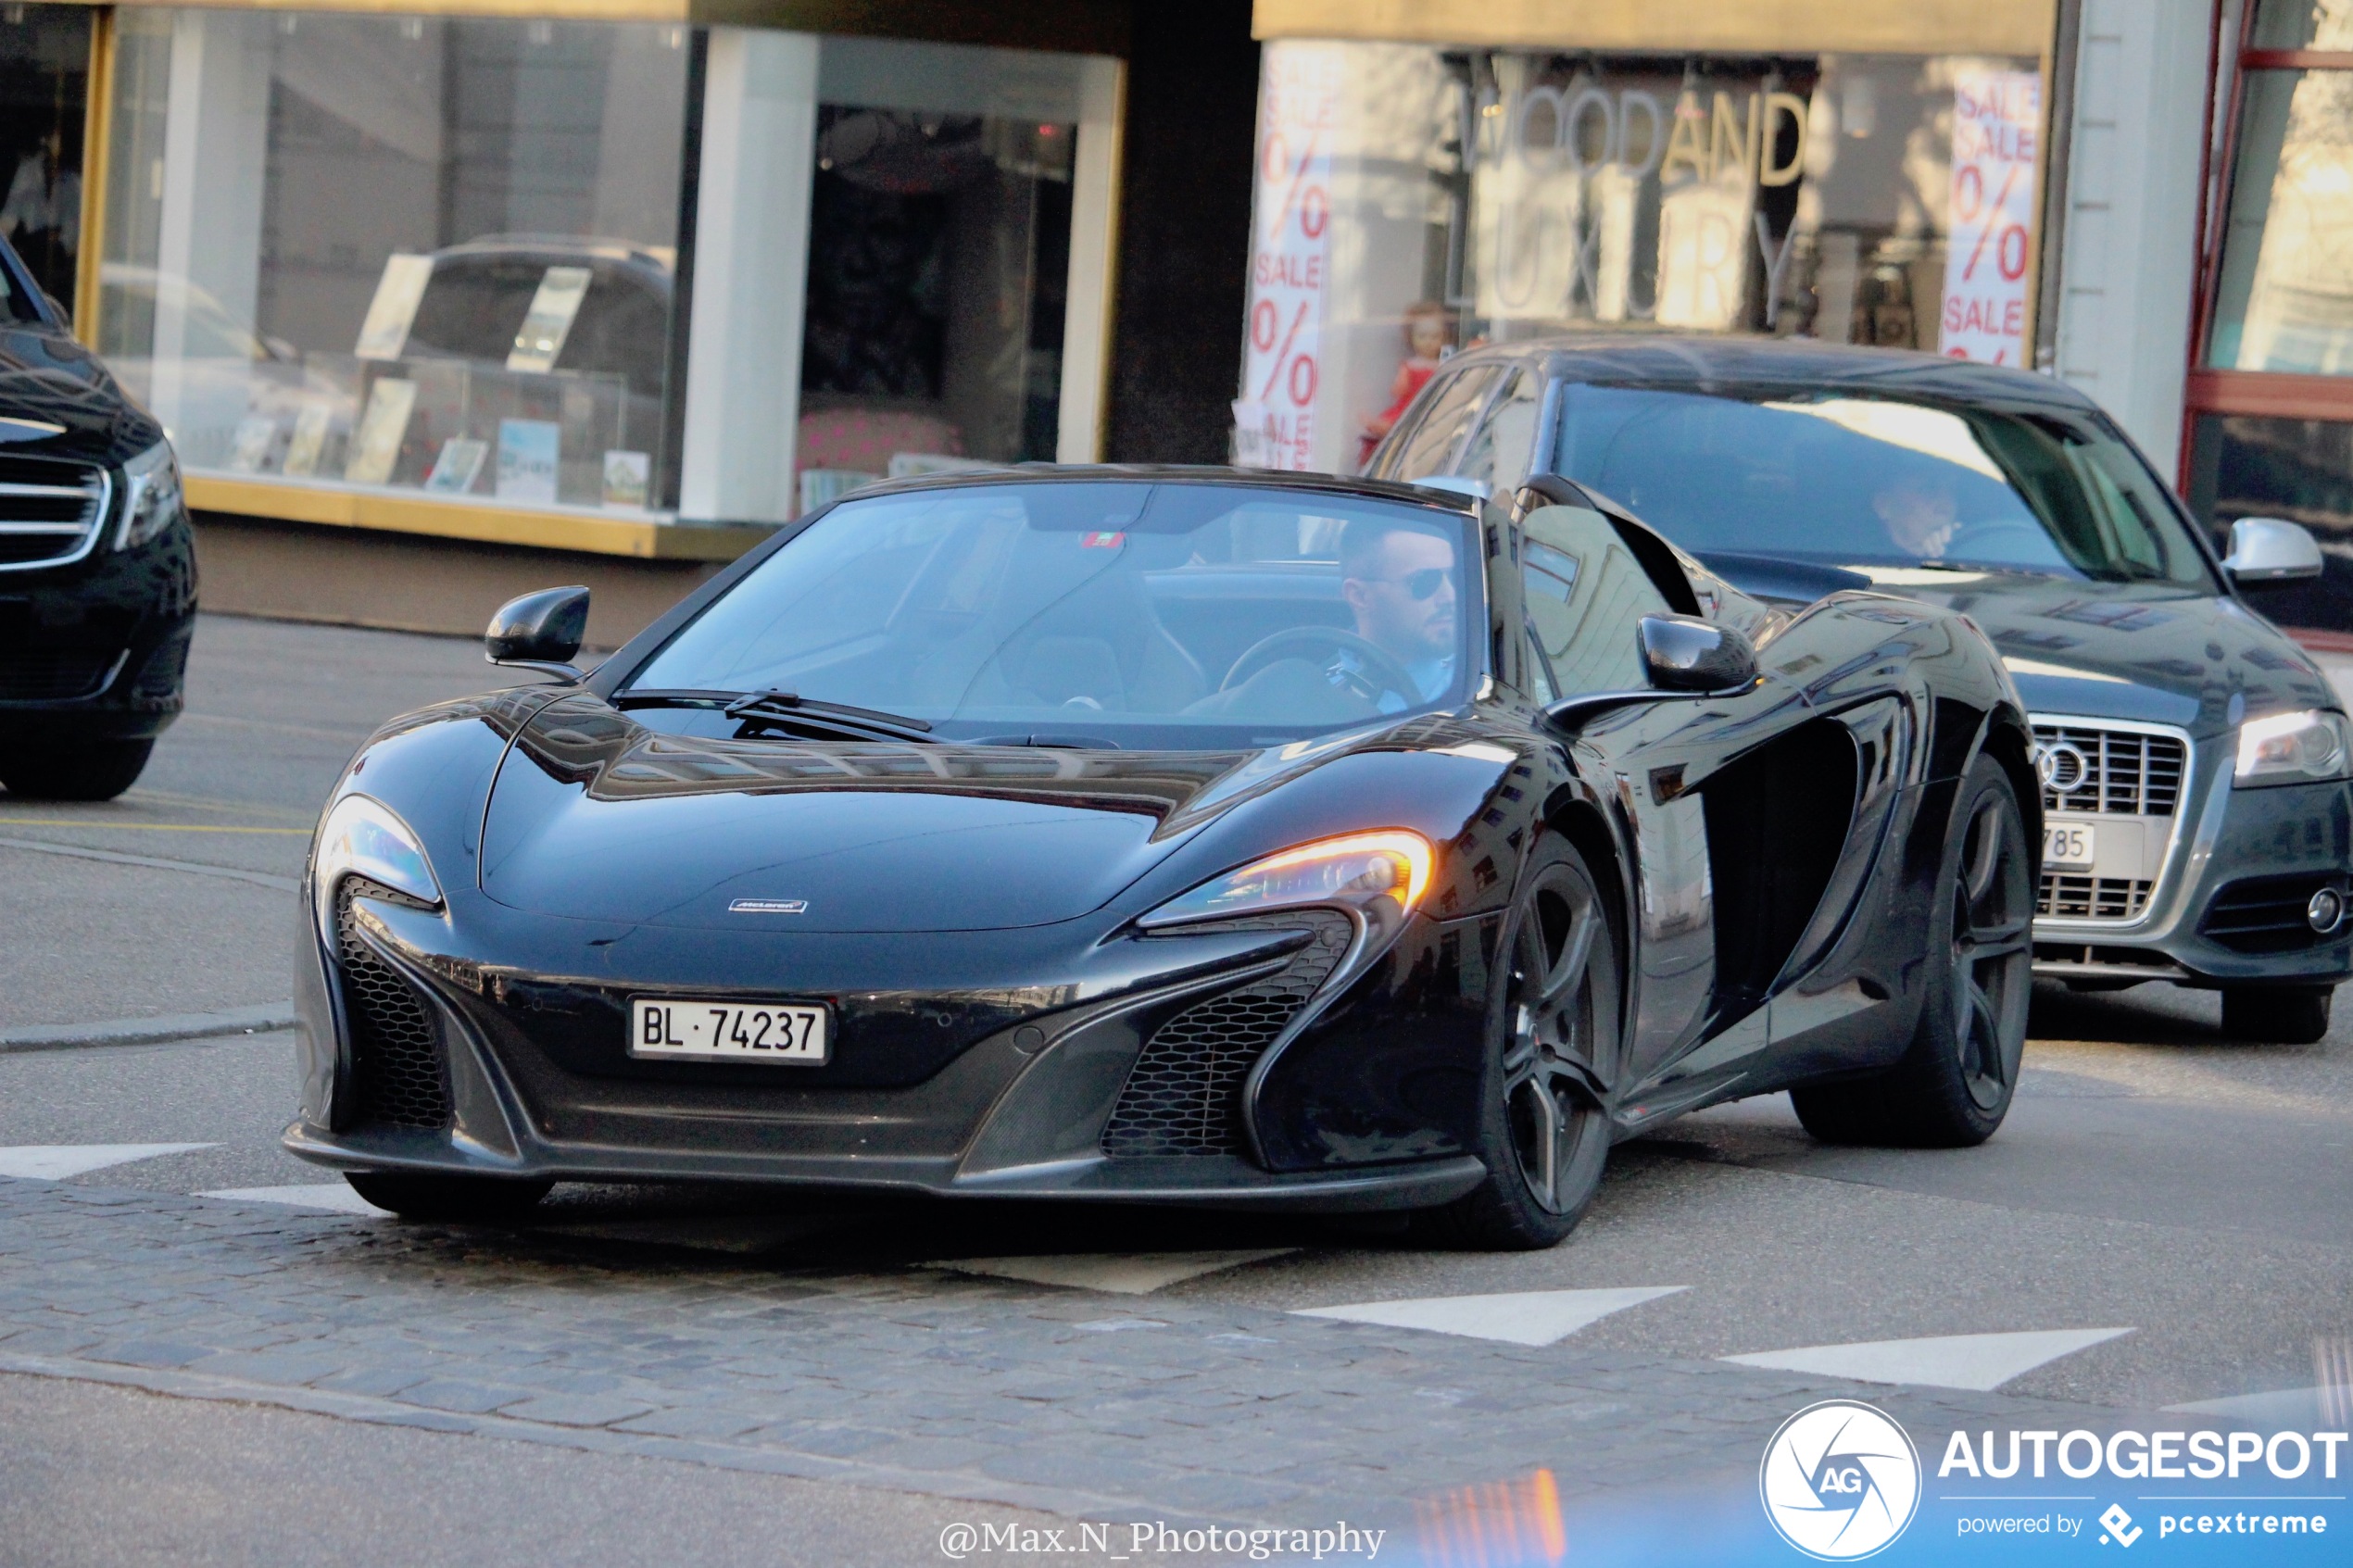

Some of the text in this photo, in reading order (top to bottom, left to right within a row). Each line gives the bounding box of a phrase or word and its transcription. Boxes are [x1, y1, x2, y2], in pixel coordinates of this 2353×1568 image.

[1957, 84, 2039, 121] SALE
[1660, 91, 1809, 187] AND
[1955, 128, 2034, 162] SALE
[1254, 253, 1320, 290] SALE
[1944, 295, 2024, 336] SALE
